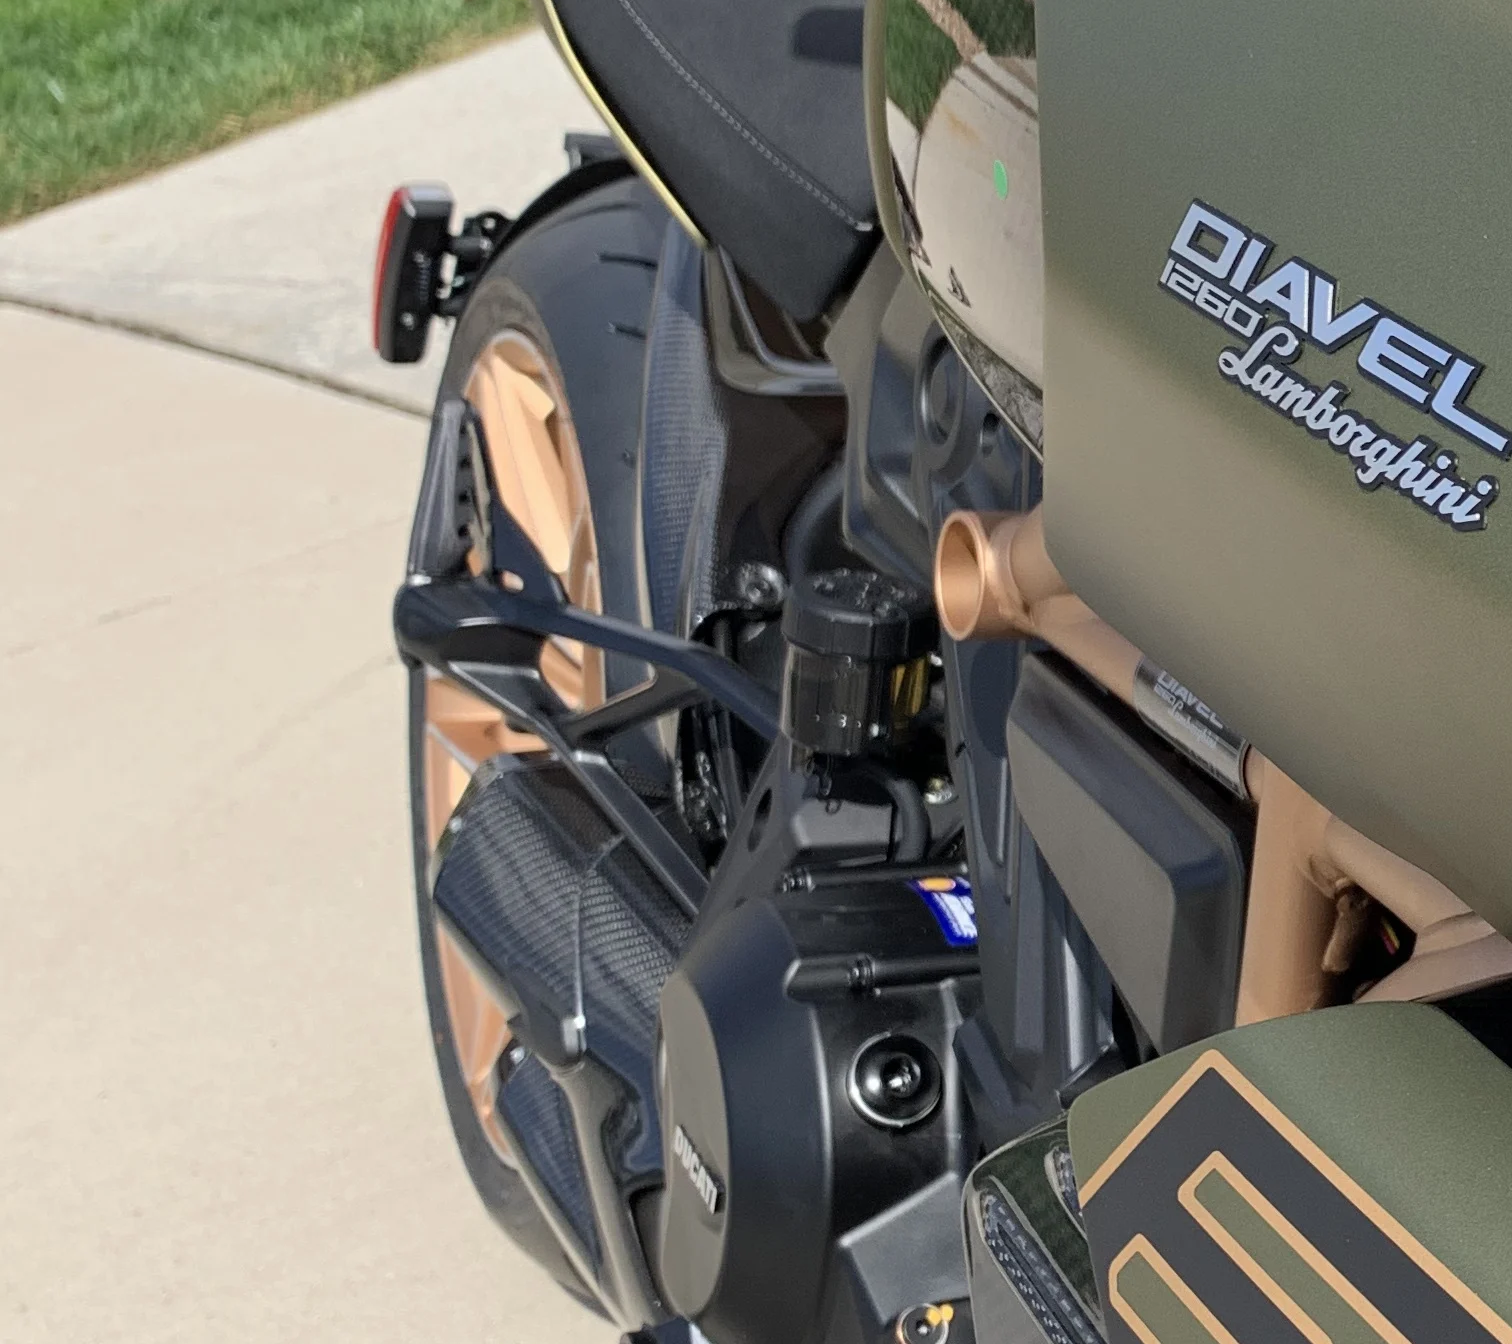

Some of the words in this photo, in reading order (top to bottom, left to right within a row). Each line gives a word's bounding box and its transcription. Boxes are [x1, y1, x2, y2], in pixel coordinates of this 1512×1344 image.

[1159, 256, 1264, 339] 1260
[1217, 322, 1496, 529] Lamborghini
[674, 1124, 718, 1214] DUCATI
